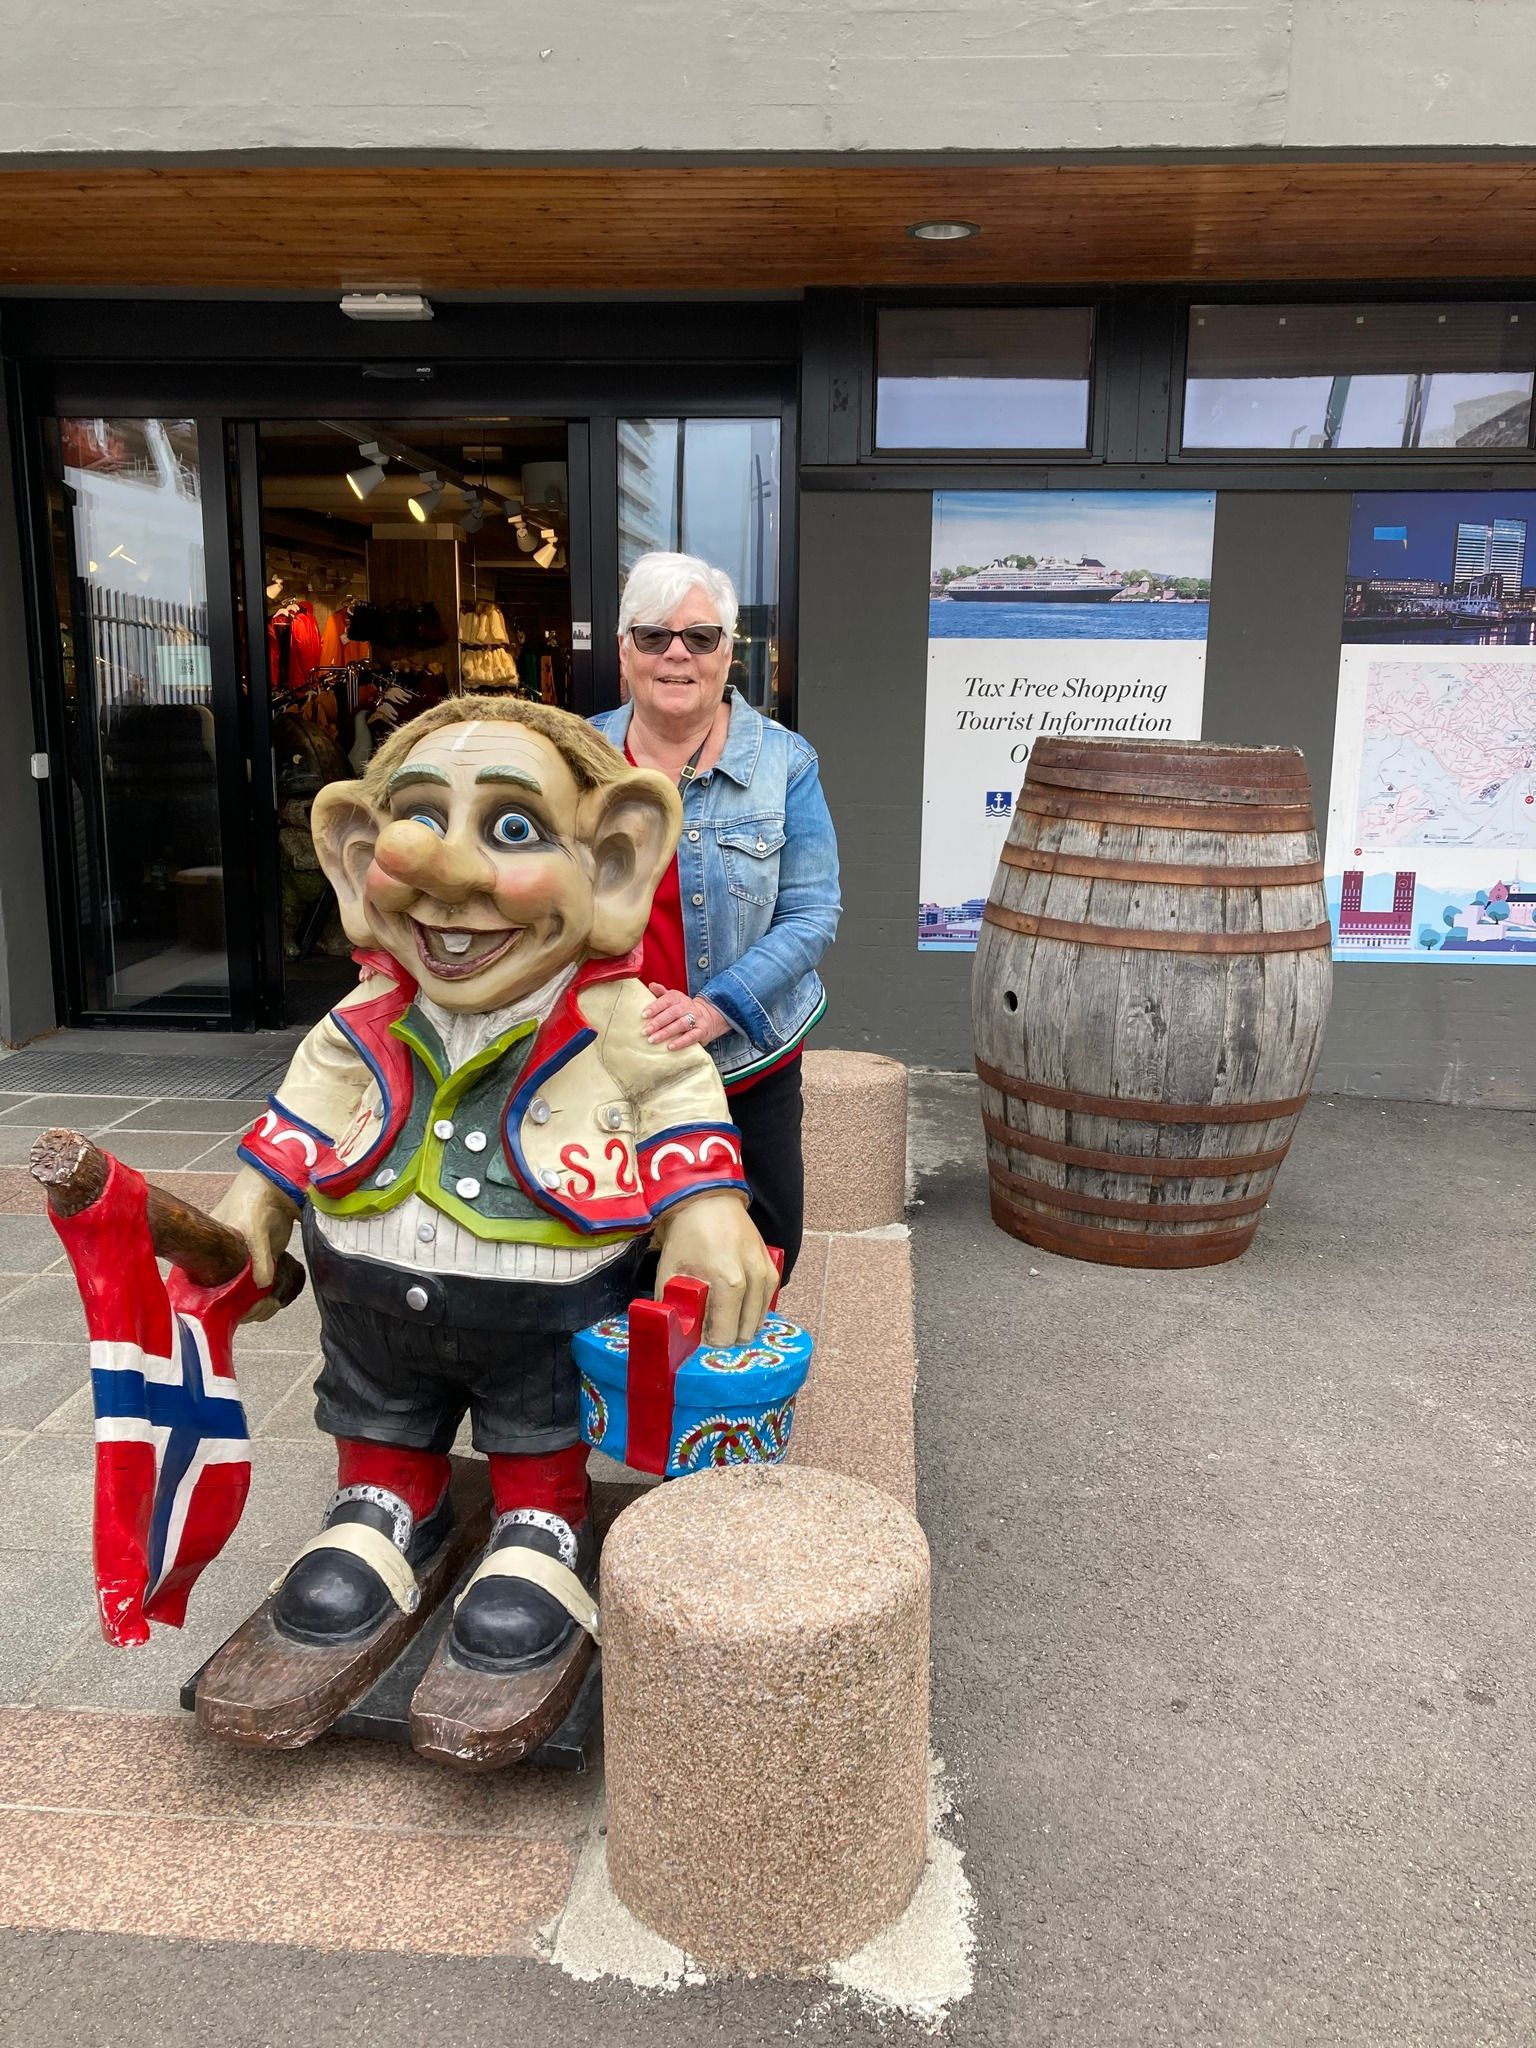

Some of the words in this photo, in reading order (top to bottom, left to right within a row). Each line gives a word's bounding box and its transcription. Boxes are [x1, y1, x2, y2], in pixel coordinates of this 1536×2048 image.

[965, 678, 1005, 697] Tax
[1008, 678, 1058, 697] Free
[1062, 678, 1167, 703] Shopping
[957, 711, 1034, 730] Tourist
[1039, 711, 1171, 735] Information
